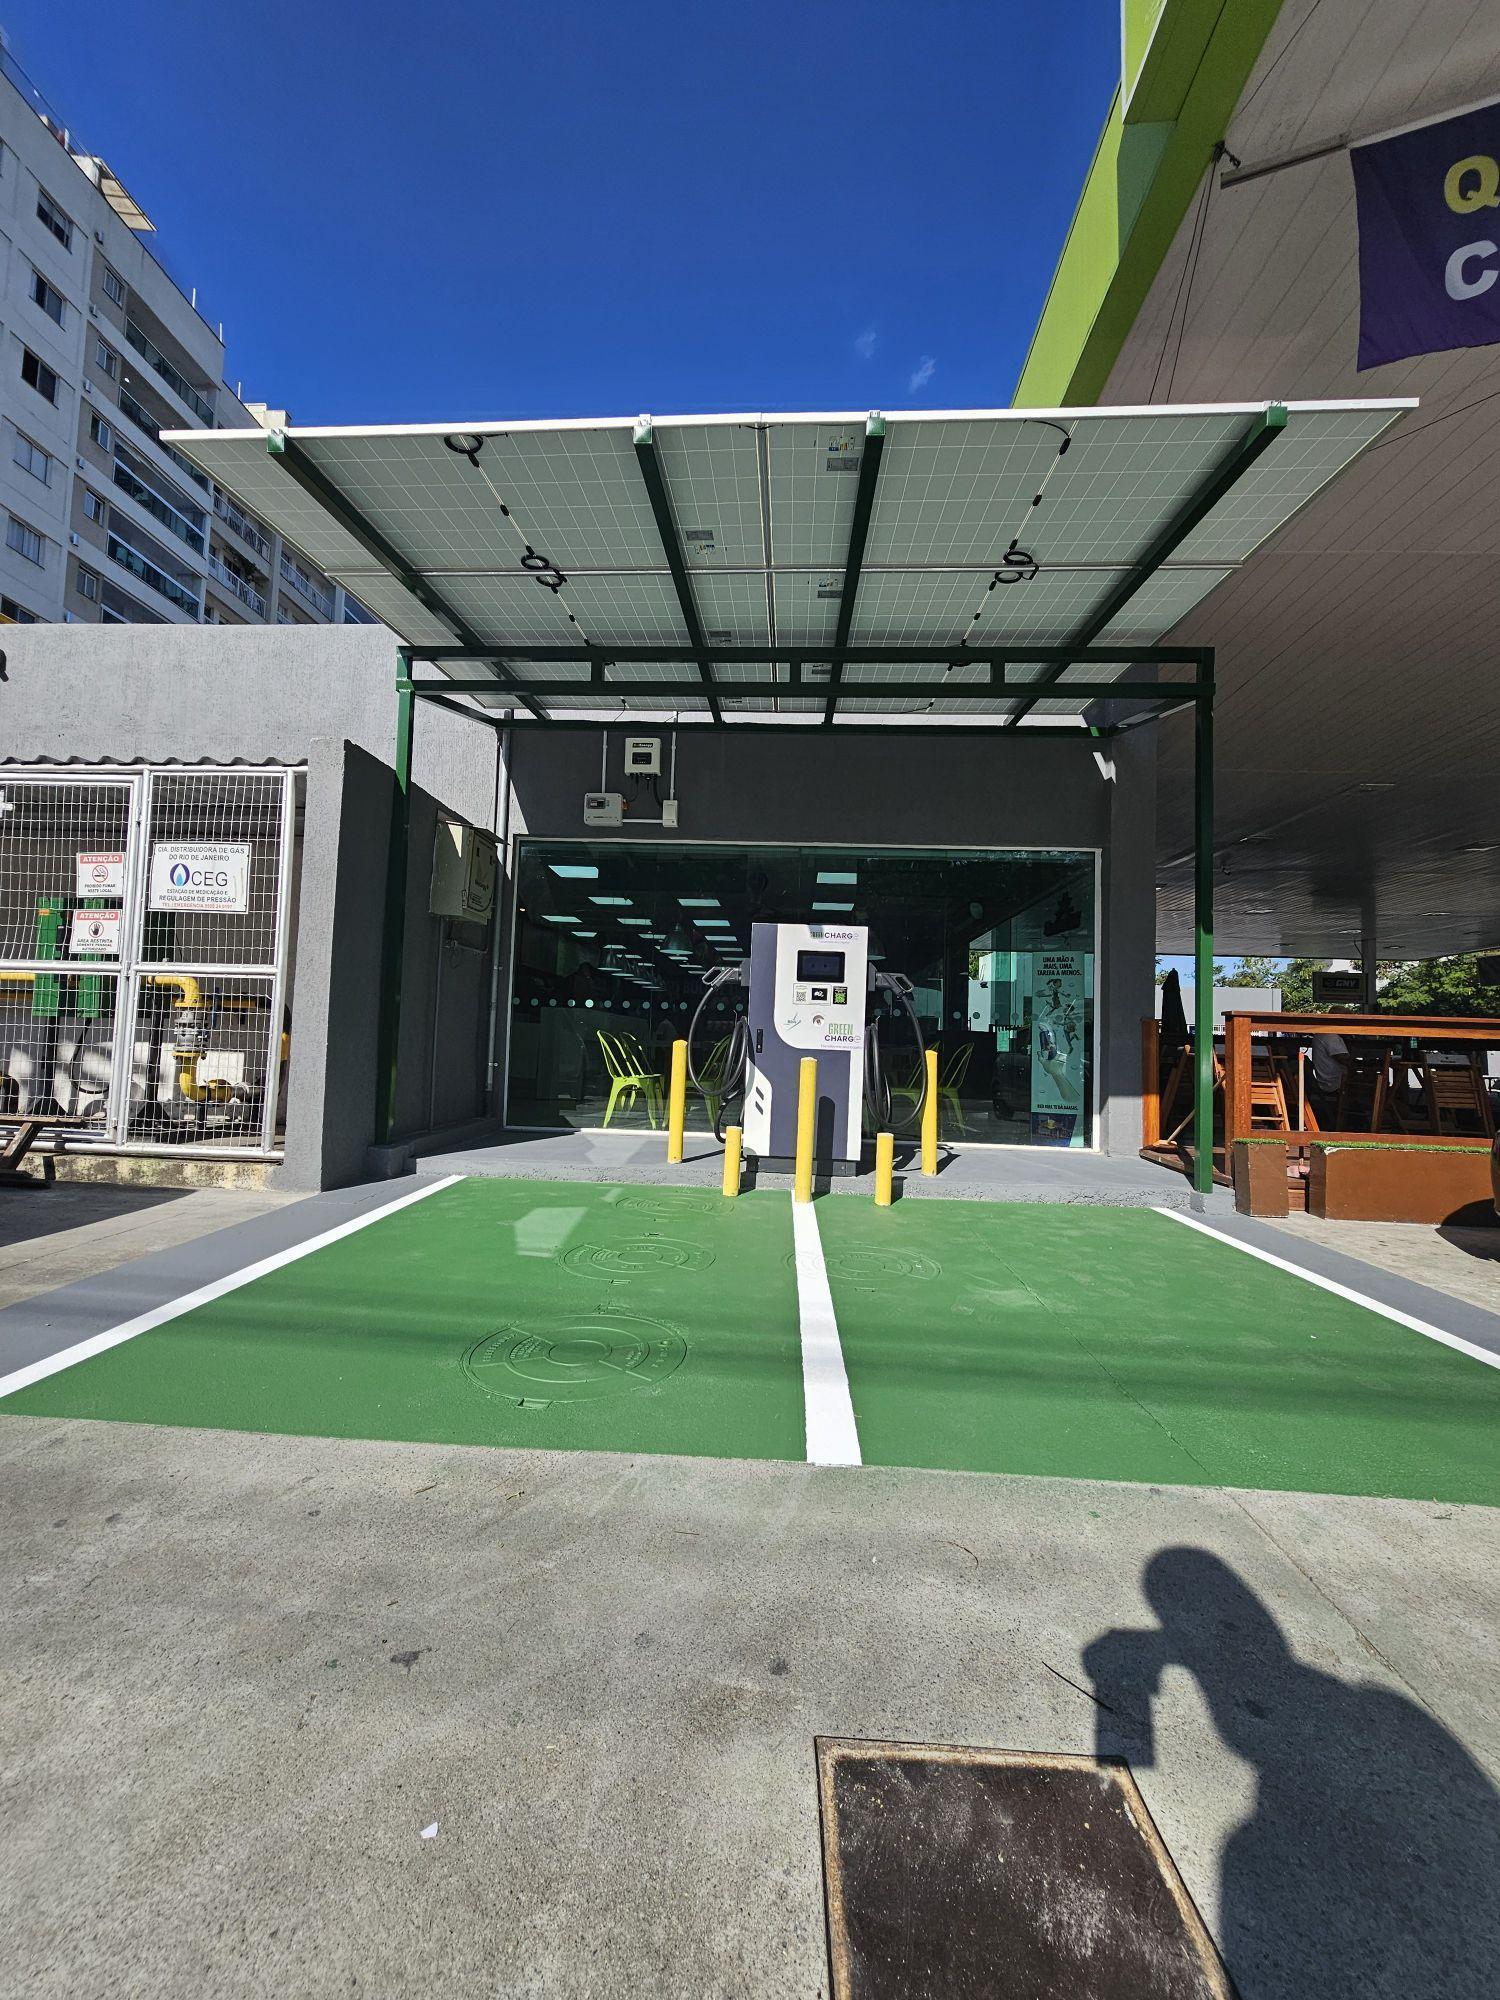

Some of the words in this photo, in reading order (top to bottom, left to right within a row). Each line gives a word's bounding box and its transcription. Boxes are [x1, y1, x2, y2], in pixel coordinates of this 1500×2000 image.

[170, 846, 218, 854] DISTRIBUIDORA
[82, 855, 120, 863] ATENÇÃO
[168, 853, 178, 861] DO
[200, 854, 230, 862] JANEIRO
[191, 870, 228, 887] CEG
[158, 894, 196, 902] REGULAGEM
[206, 896, 237, 904] PRESSÃO
[79, 911, 116, 920] ATENÇÃO
[1056, 955, 1070, 963] MÃO
[828, 1023, 854, 1036] GREEN
